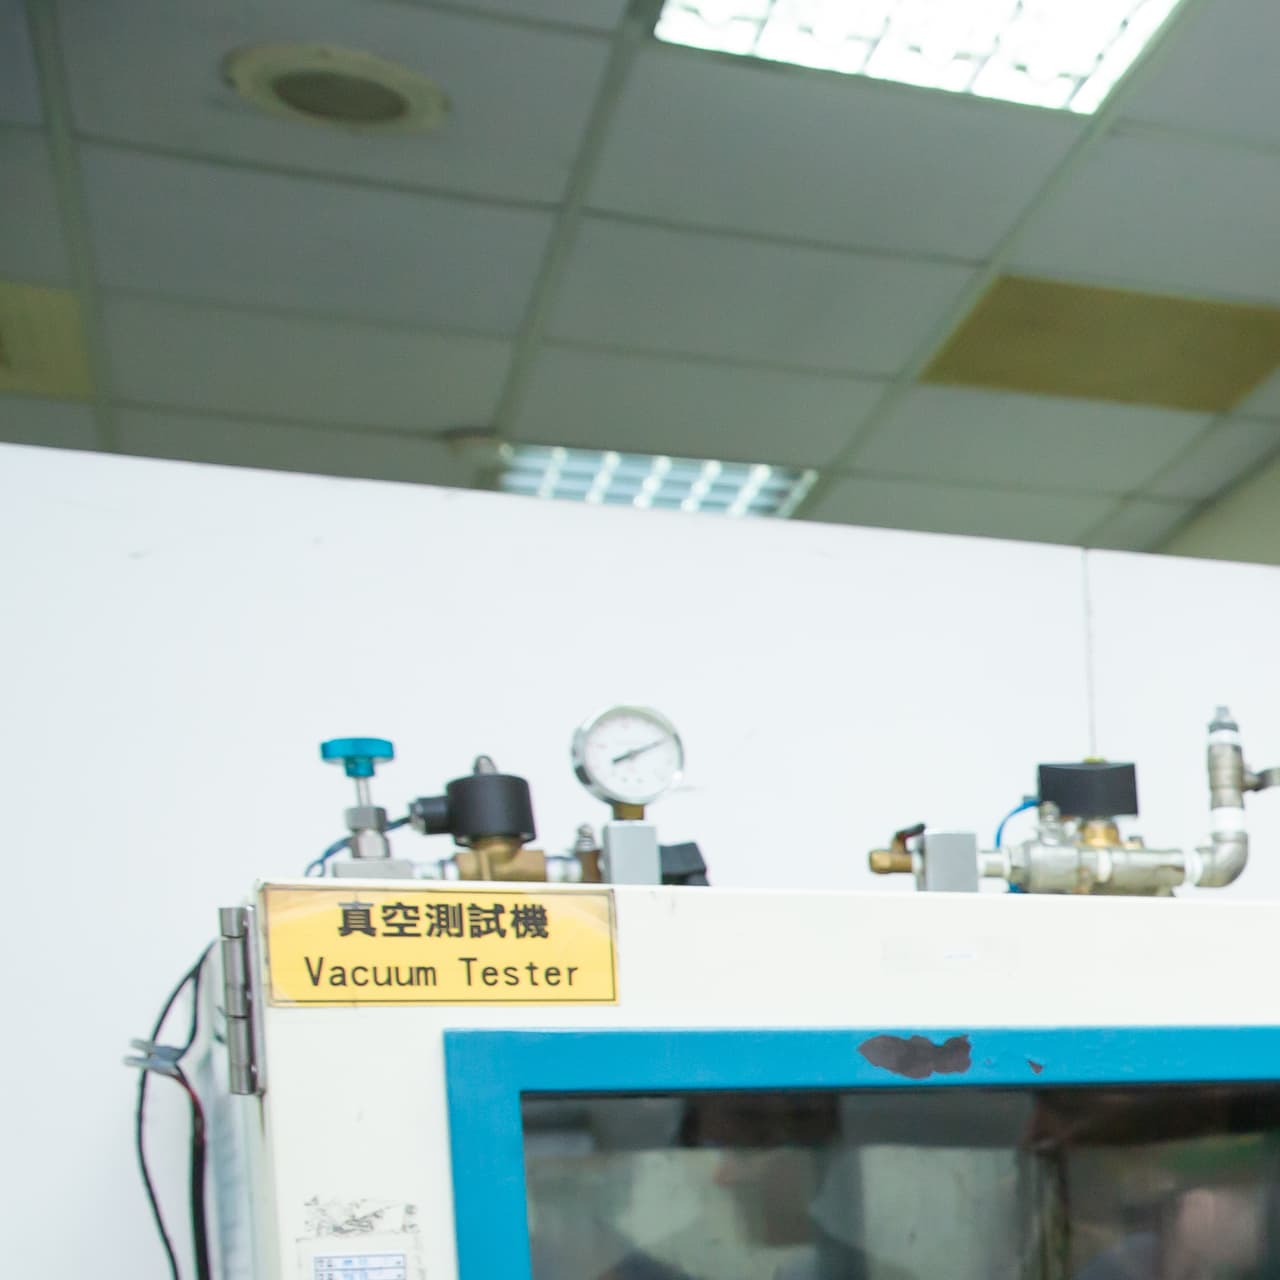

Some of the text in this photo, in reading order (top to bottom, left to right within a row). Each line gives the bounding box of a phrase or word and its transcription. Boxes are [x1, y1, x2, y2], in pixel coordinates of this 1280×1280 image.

[337, 901, 549, 938] 真空測試機
[303, 956, 579, 987] Vacuum Tester
